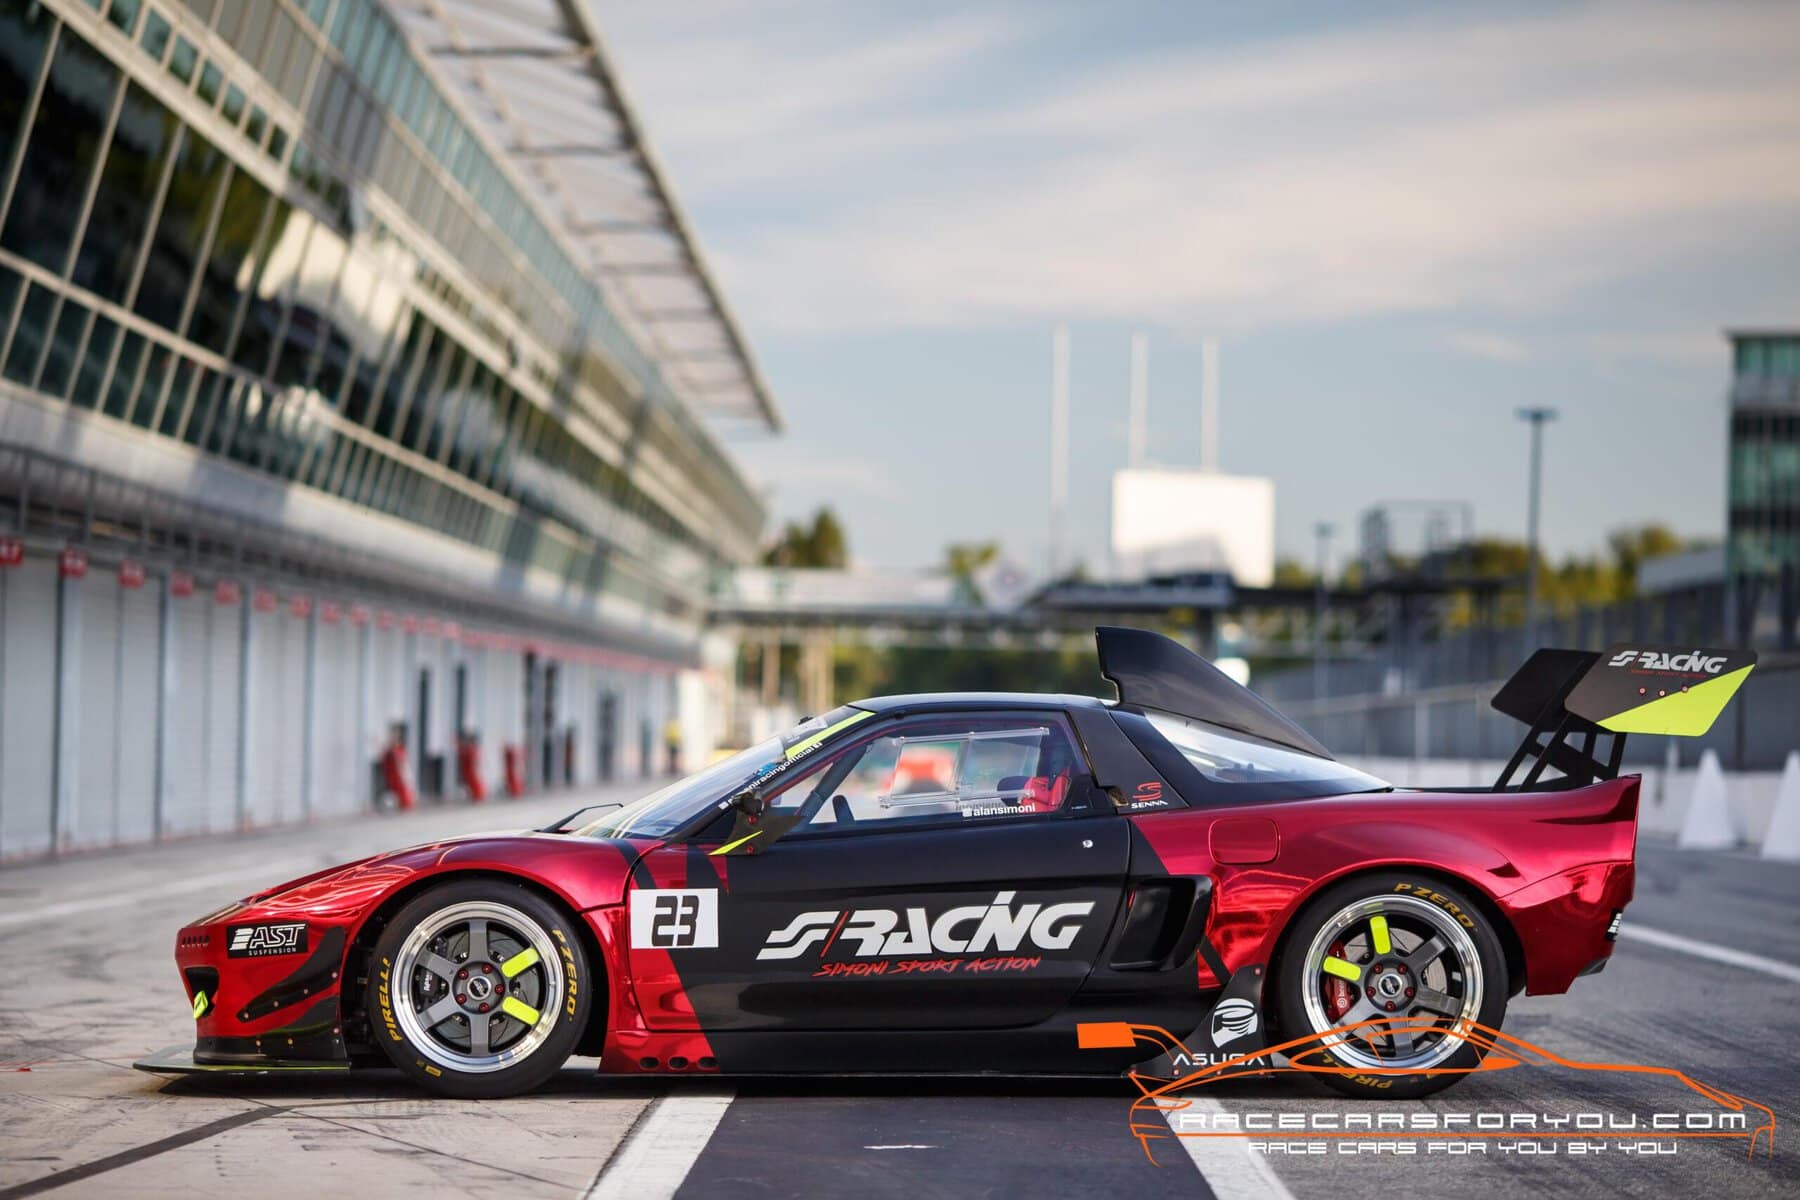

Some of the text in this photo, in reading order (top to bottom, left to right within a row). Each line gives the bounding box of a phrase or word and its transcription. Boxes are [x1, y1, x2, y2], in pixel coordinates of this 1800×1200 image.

[1130, 800, 1169, 809] SENNA
[652, 895, 699, 946] 23
[1393, 883, 1476, 929] P ZERO
[248, 947, 297, 956] SUSPENSION
[249, 924, 306, 949] AST
[551, 929, 578, 1017] P ZERO
[811, 955, 1042, 977] SIMONI SPORT ACTION
[378, 957, 403, 1042] PIRELLI
